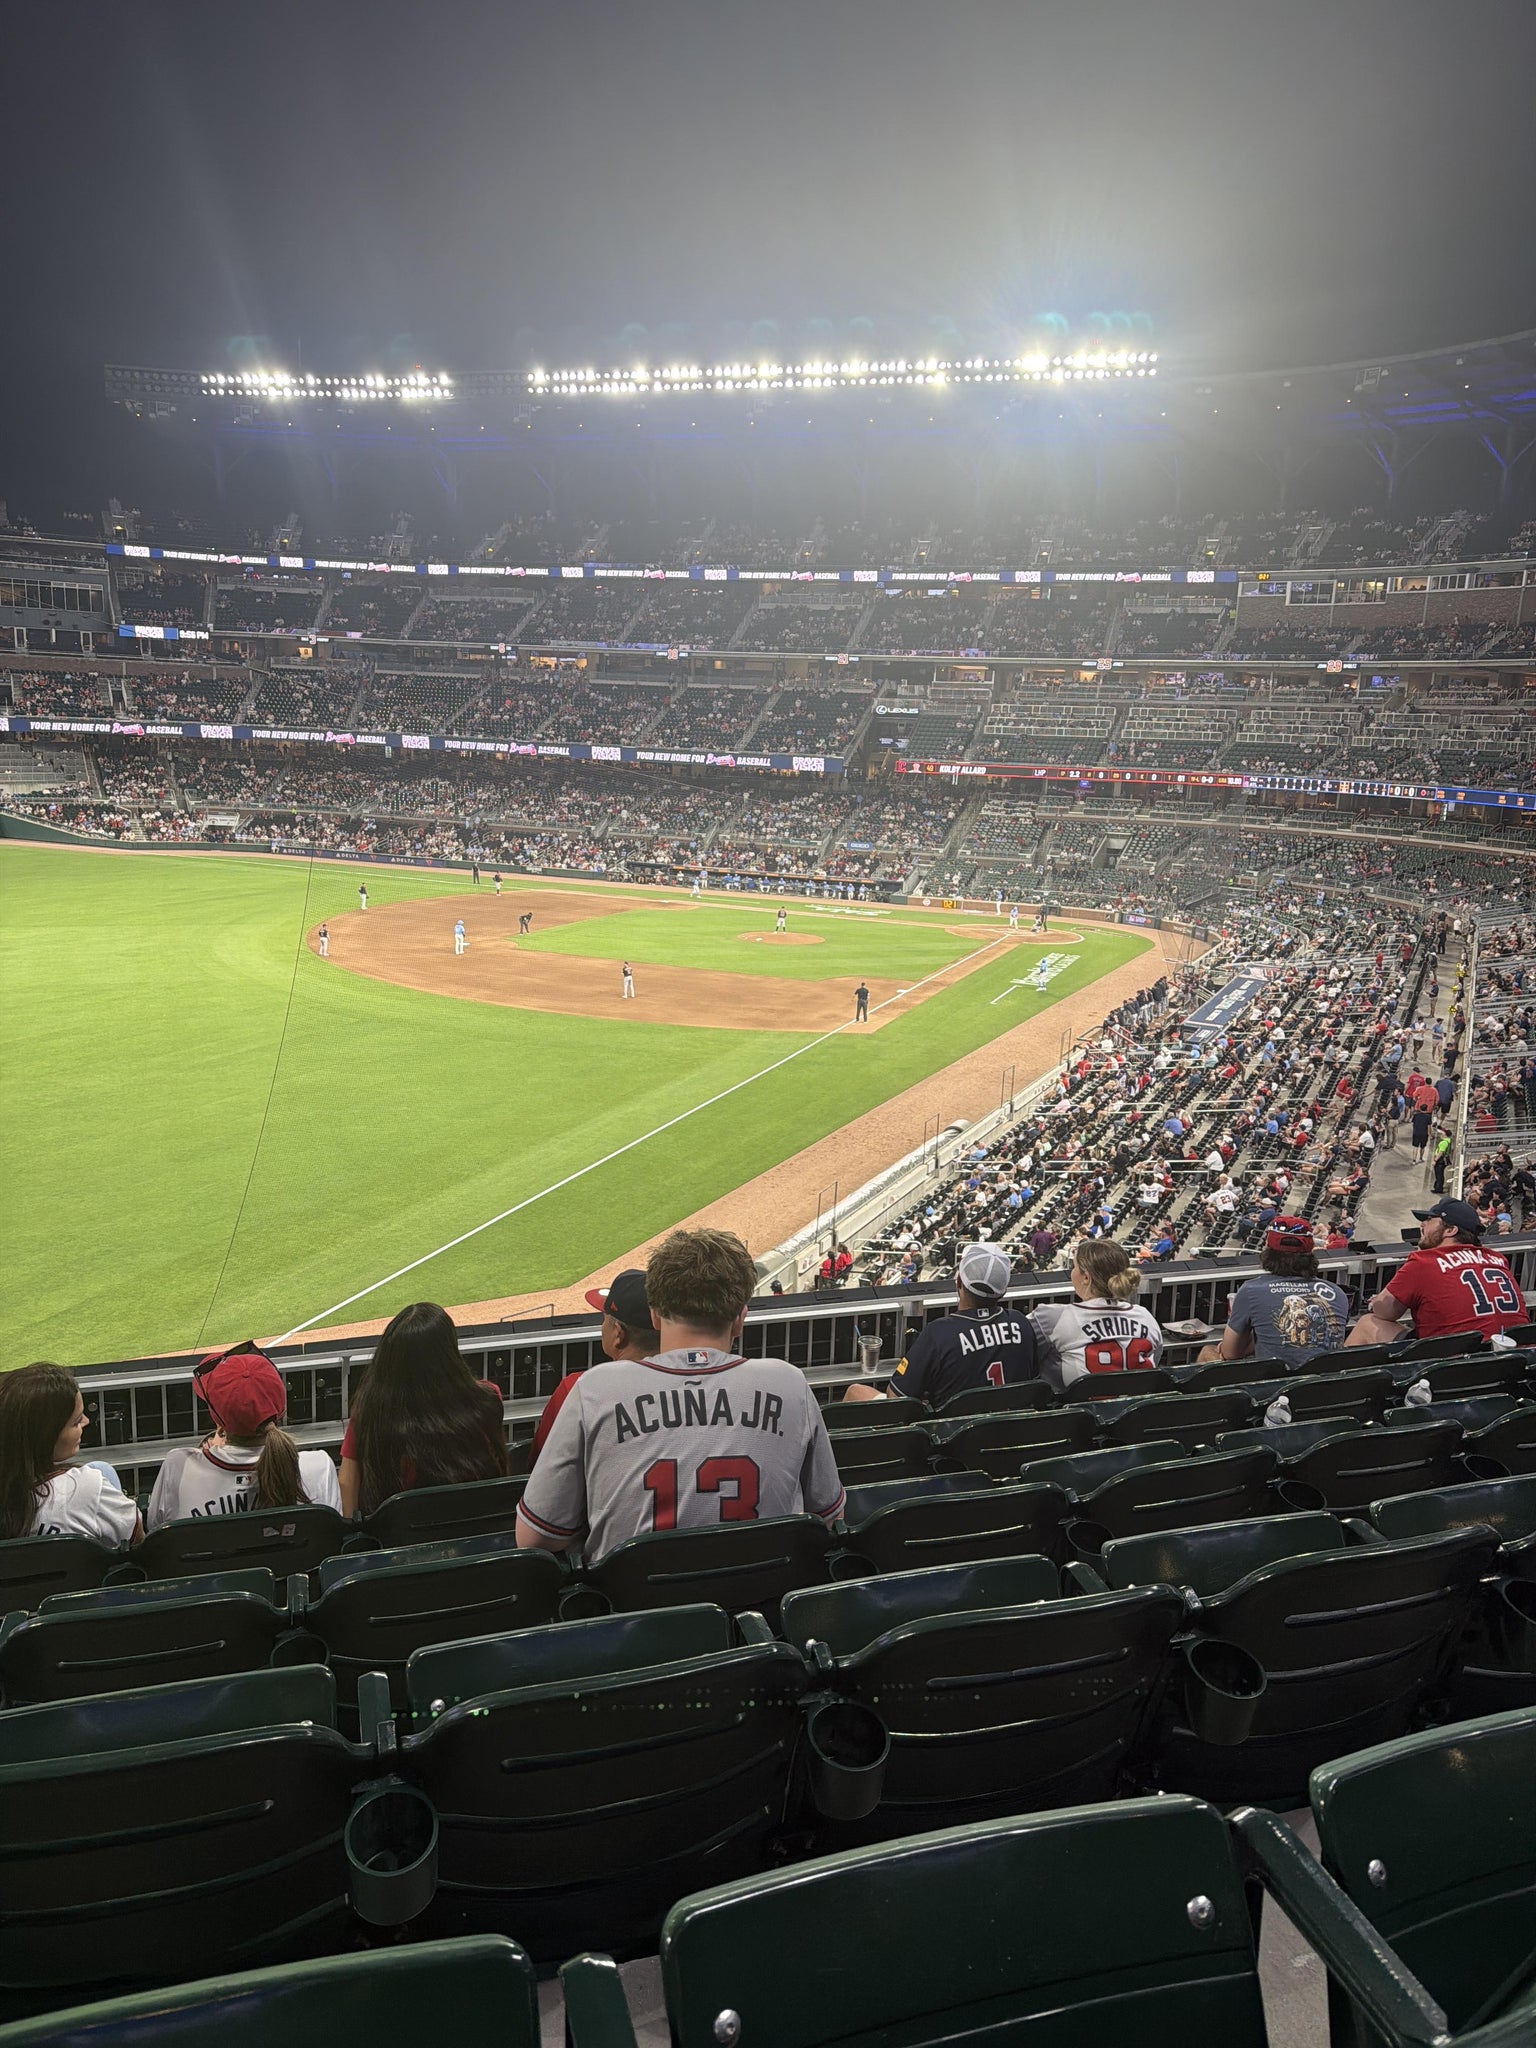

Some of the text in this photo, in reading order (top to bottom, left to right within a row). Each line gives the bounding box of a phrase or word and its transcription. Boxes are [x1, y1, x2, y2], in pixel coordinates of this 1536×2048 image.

[30, 722, 51, 730] YOUR
[52, 722, 71, 730] NEW
[71, 723, 94, 731] HOME
[95, 724, 110, 732] FOR
[146, 726, 183, 735] BASEBALL
[252, 730, 271, 738] YOUR
[271, 731, 288, 739] NEW
[288, 732, 309, 740] HOME
[310, 733, 324, 741] FOR
[356, 735, 386, 744] BASEBALL
[402, 741, 429, 749] VISION
[496, 743, 509, 751] FOR
[538, 746, 570, 755] BASEBALL
[637, 752, 654, 760] YOUR
[654, 753, 670, 761] NEW
[671, 754, 690, 762] HOME
[691, 755, 705, 763] FOR
[737, 757, 771, 766] BASEBALL
[793, 763, 824, 771] VISION
[939, 765, 986, 774] KOLBY ALLARD
[1460, 1268, 1520, 1316] 13
[959, 1322, 1022, 1356] ALBIES
[615, 1380, 784, 1443] ACUÑA JR.
[643, 1455, 760, 1532] 13
